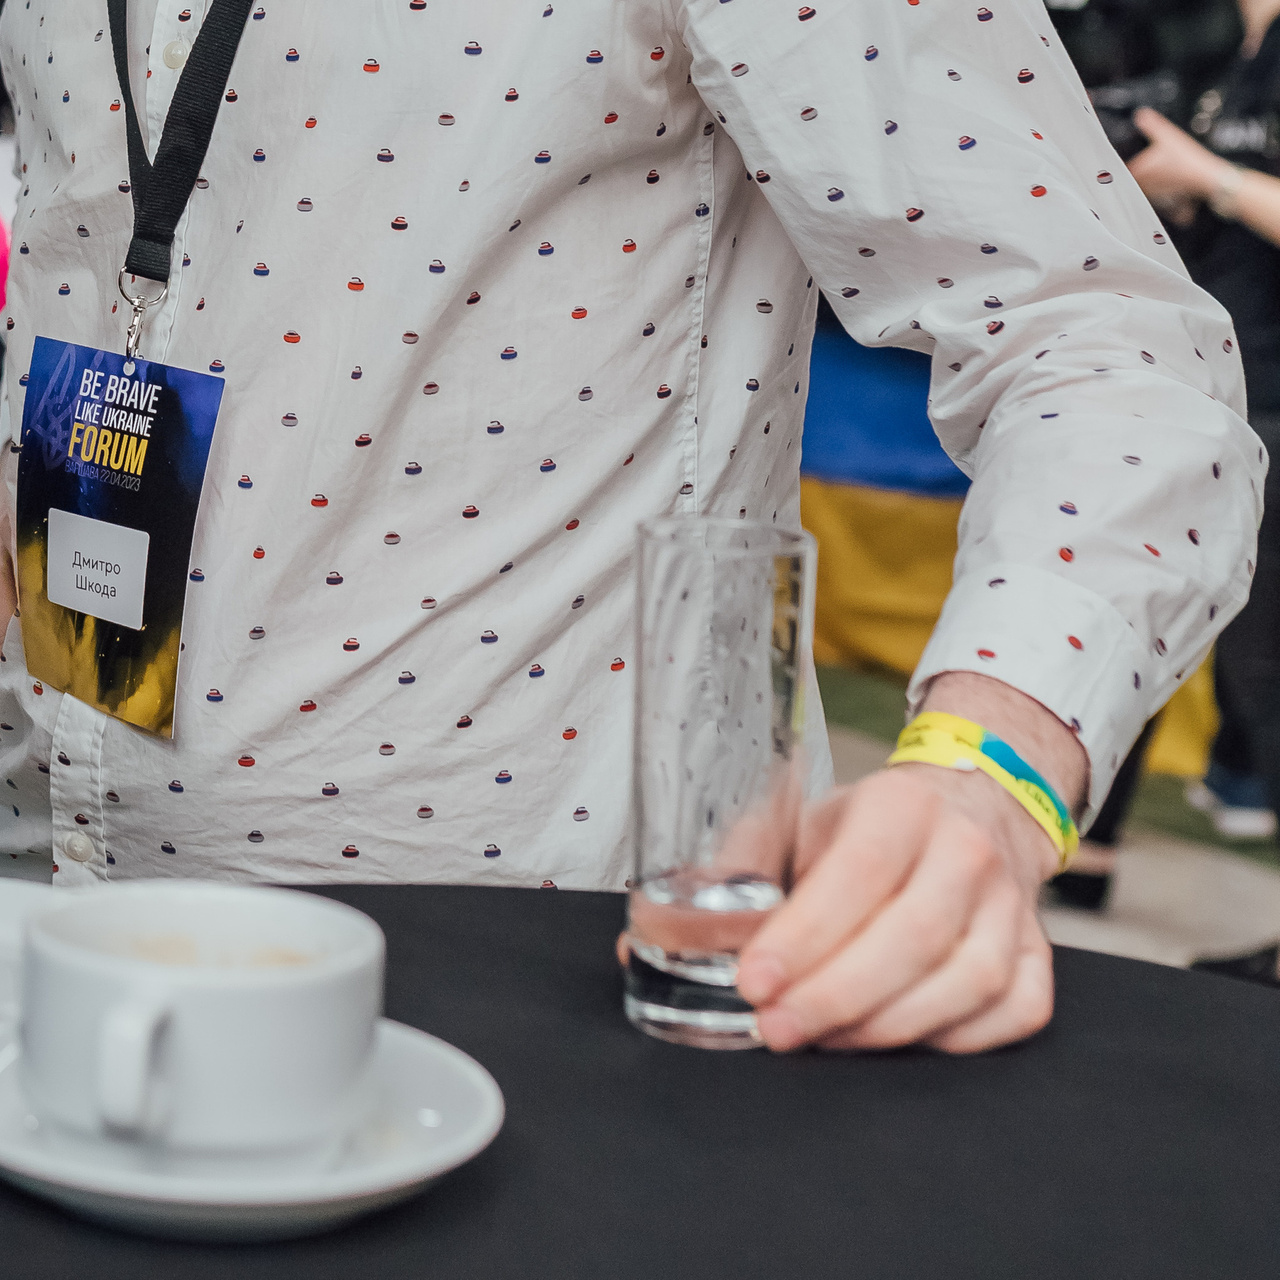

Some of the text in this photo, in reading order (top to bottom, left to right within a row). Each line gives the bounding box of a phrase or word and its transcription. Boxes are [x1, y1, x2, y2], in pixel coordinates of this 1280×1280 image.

[79, 368, 162, 414] BE BRAVE
[74, 400, 154, 438] LIKE UKRAINE
[67, 422, 149, 476] FORUM
[72, 550, 121, 577] Дмитро
[75, 573, 117, 600] Шкода
